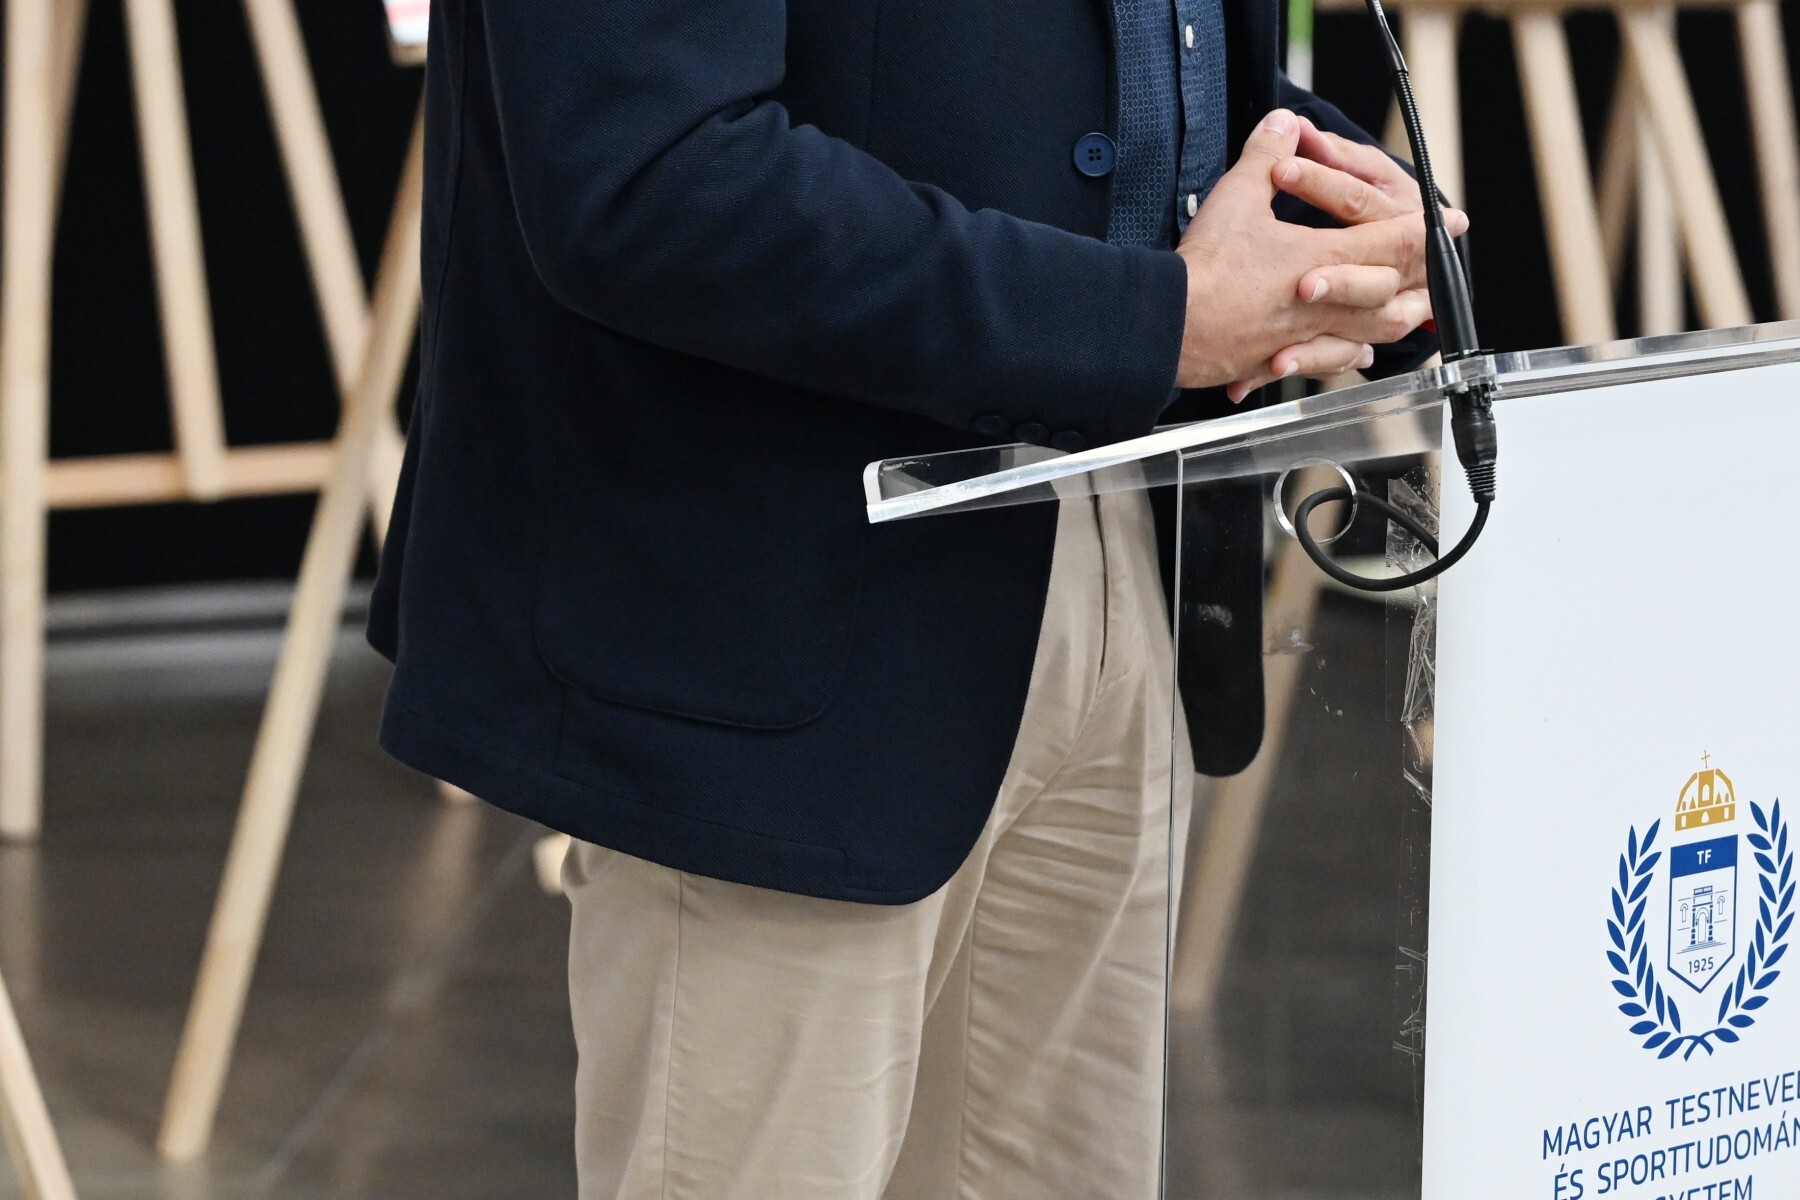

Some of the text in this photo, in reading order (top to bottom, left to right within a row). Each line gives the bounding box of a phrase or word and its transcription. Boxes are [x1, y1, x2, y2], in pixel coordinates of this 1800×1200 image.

[1696, 848, 1712, 865] TF
[1688, 956, 1714, 974] 1925
[1542, 1105, 1653, 1161] MAGYAR
[1553, 1162, 1584, 1200] ÉS
